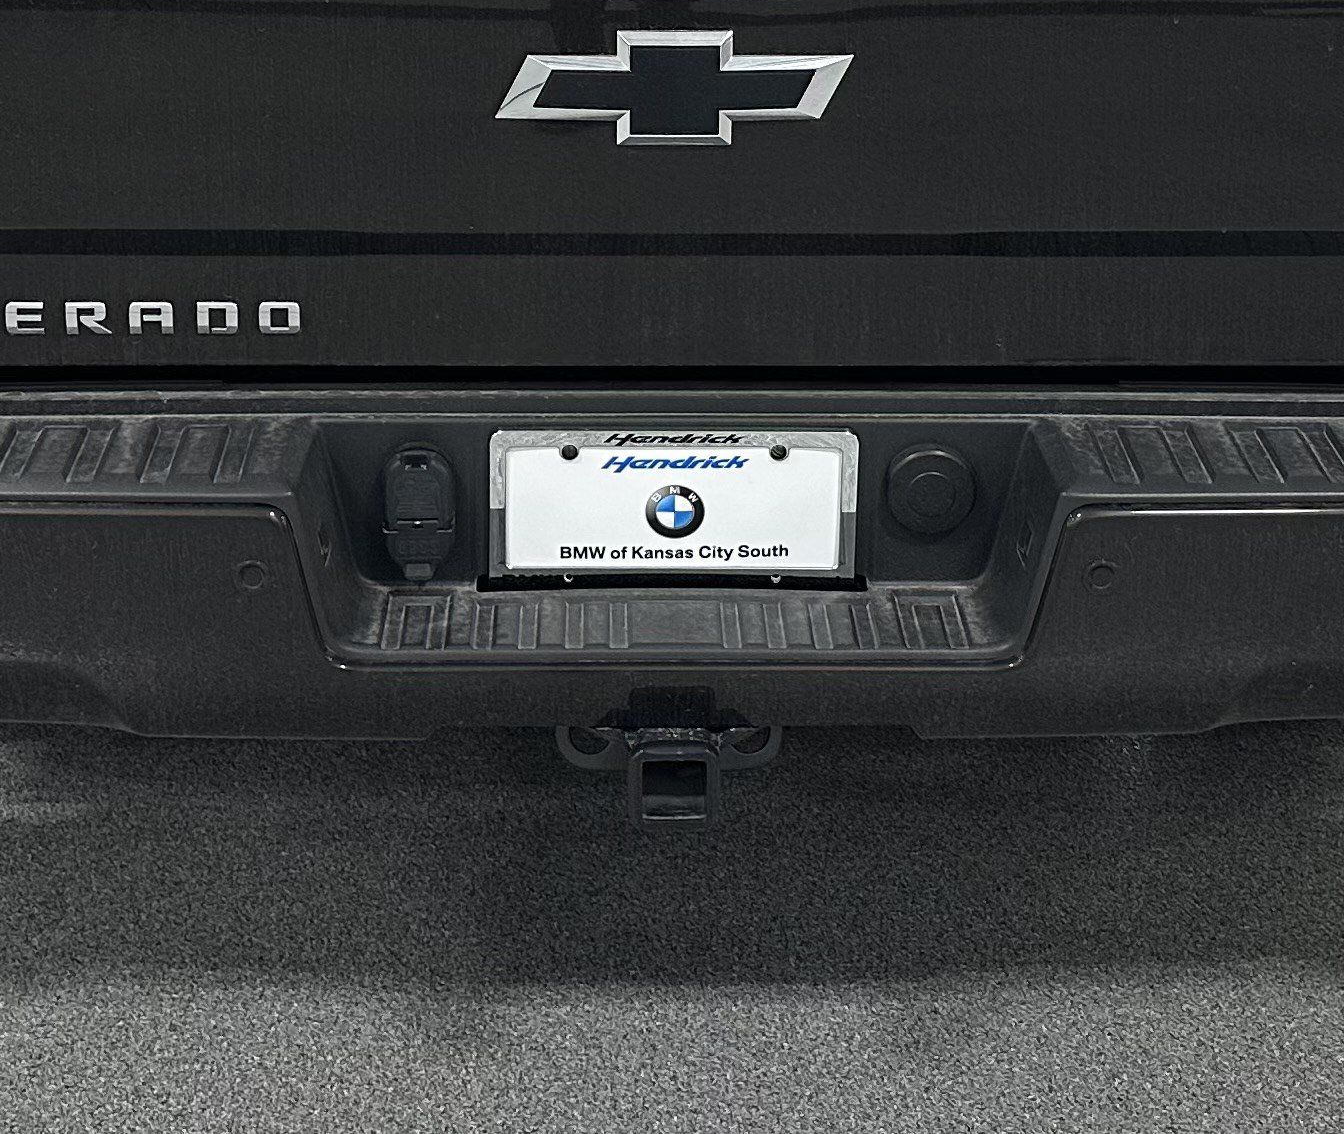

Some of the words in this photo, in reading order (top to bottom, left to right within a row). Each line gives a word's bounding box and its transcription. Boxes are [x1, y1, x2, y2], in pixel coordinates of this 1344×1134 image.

[604, 432, 747, 447] Hendrick
[601, 454, 750, 474] Hendrick
[651, 485, 699, 503] BMW
[559, 545, 606, 560] BMW
[610, 546, 628, 560] of
[631, 545, 694, 560] Kansas
[698, 545, 733, 562] City
[737, 544, 790, 559] South
